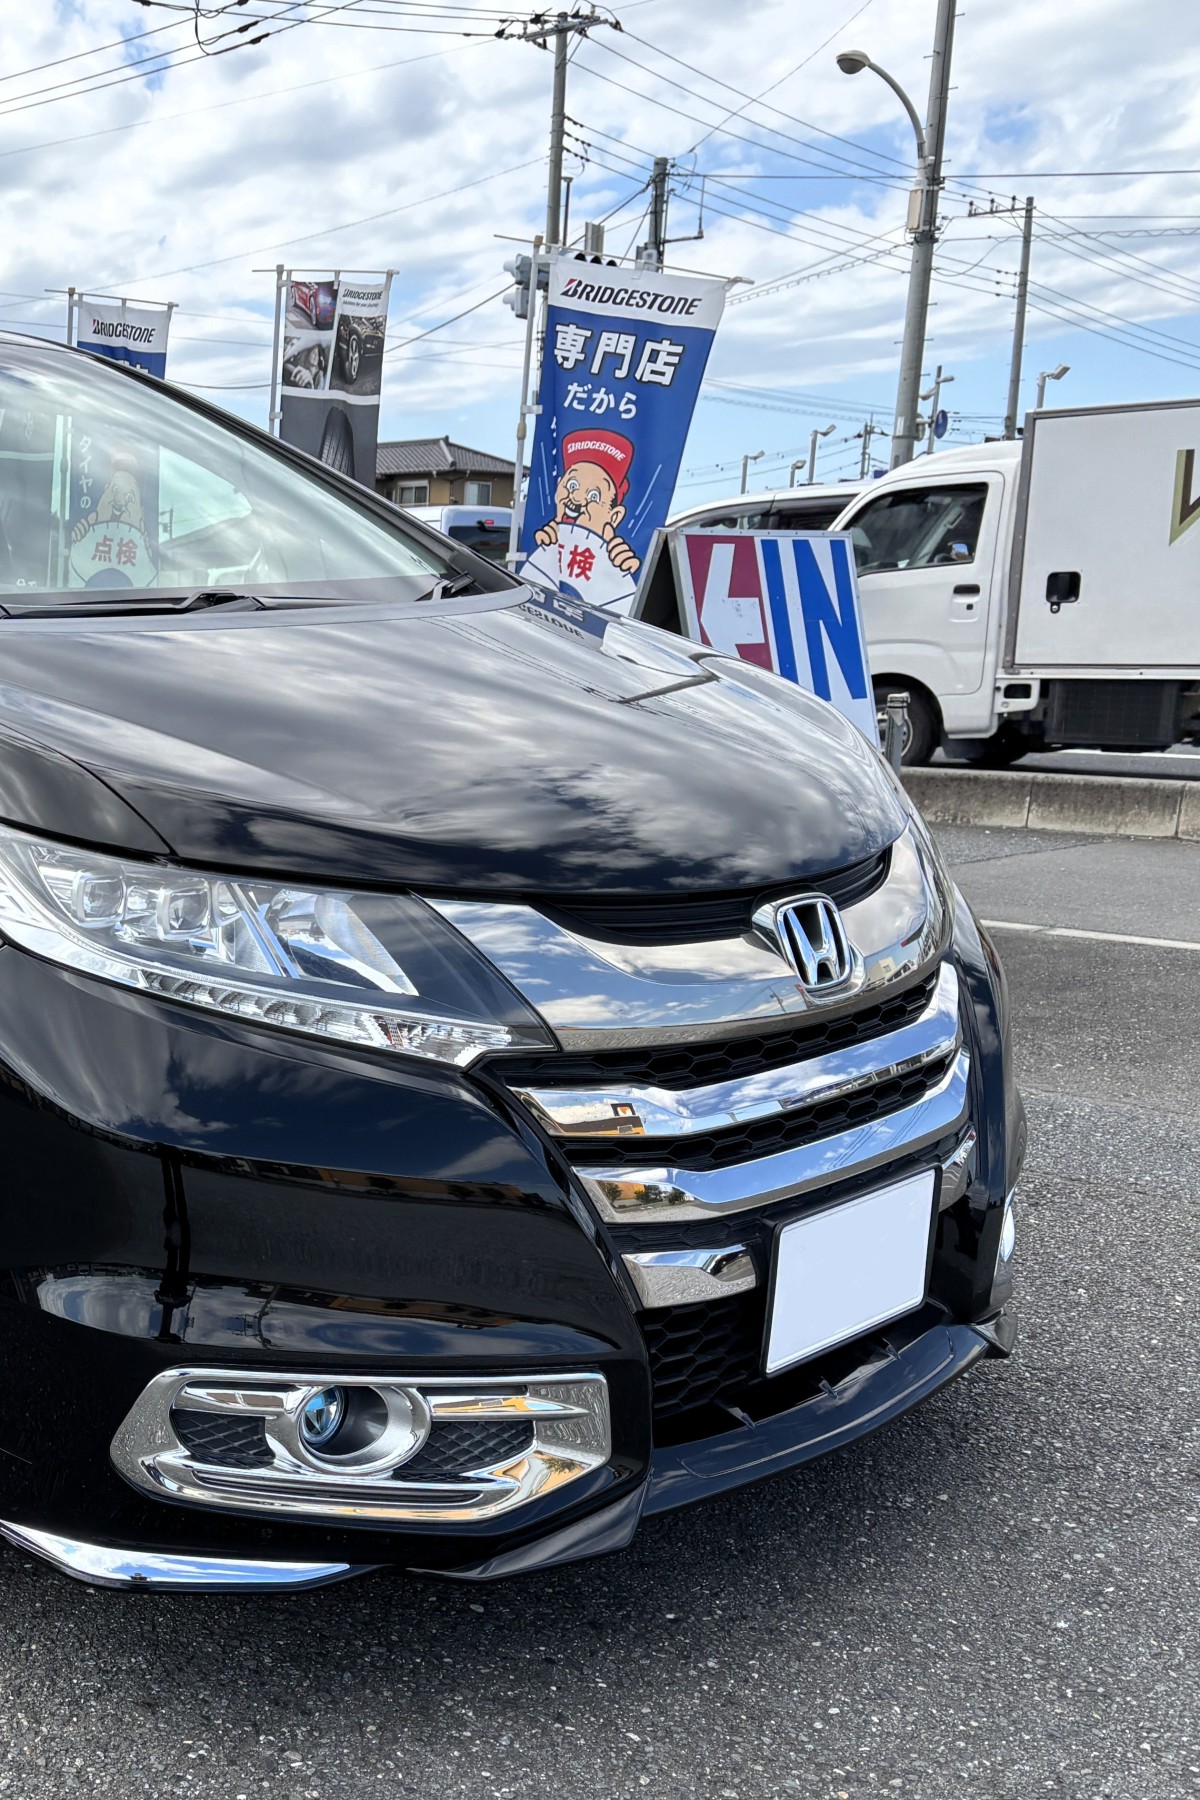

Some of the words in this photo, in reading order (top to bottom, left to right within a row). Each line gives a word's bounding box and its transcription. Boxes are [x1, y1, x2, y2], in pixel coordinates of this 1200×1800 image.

[342, 289, 383, 300] BRIDGESTONE
[560, 278, 702, 315] BRIDGESTONE
[92, 319, 156, 343] BRIDGESTONE
[553, 323, 684, 387] 専門店
[563, 382, 637, 419] だから
[567, 440, 626, 462] BRIDGESTONE
[79, 434, 93, 509] タイヤの
[91, 534, 138, 567] 点検
[761, 539, 868, 701] IN
